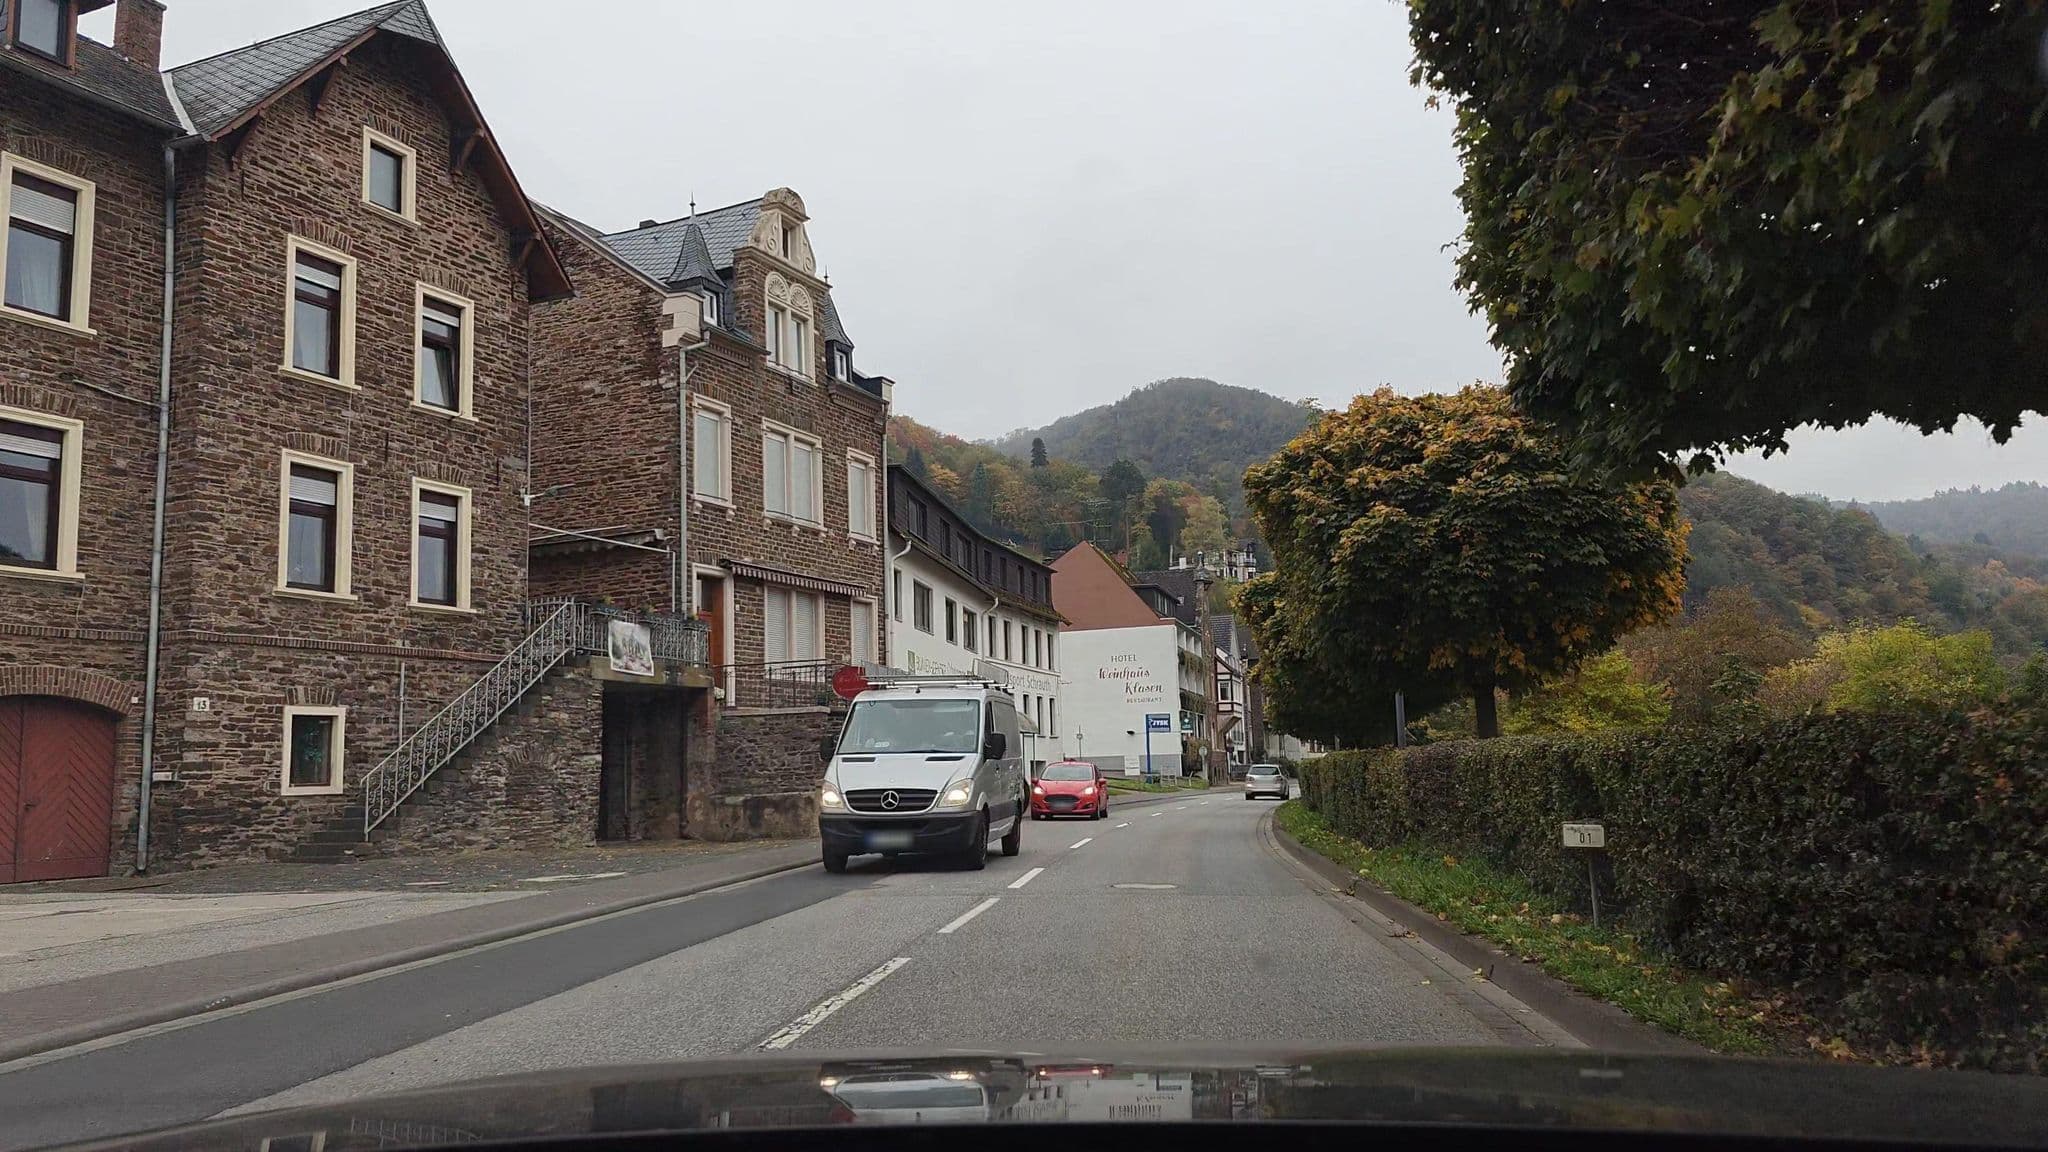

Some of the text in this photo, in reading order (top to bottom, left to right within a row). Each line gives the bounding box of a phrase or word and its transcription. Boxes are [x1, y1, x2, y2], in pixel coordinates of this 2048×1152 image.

[1111, 654, 1137, 662] HOTEL
[1125, 681, 1163, 695] Klasen
[197, 700, 207, 710] 13
